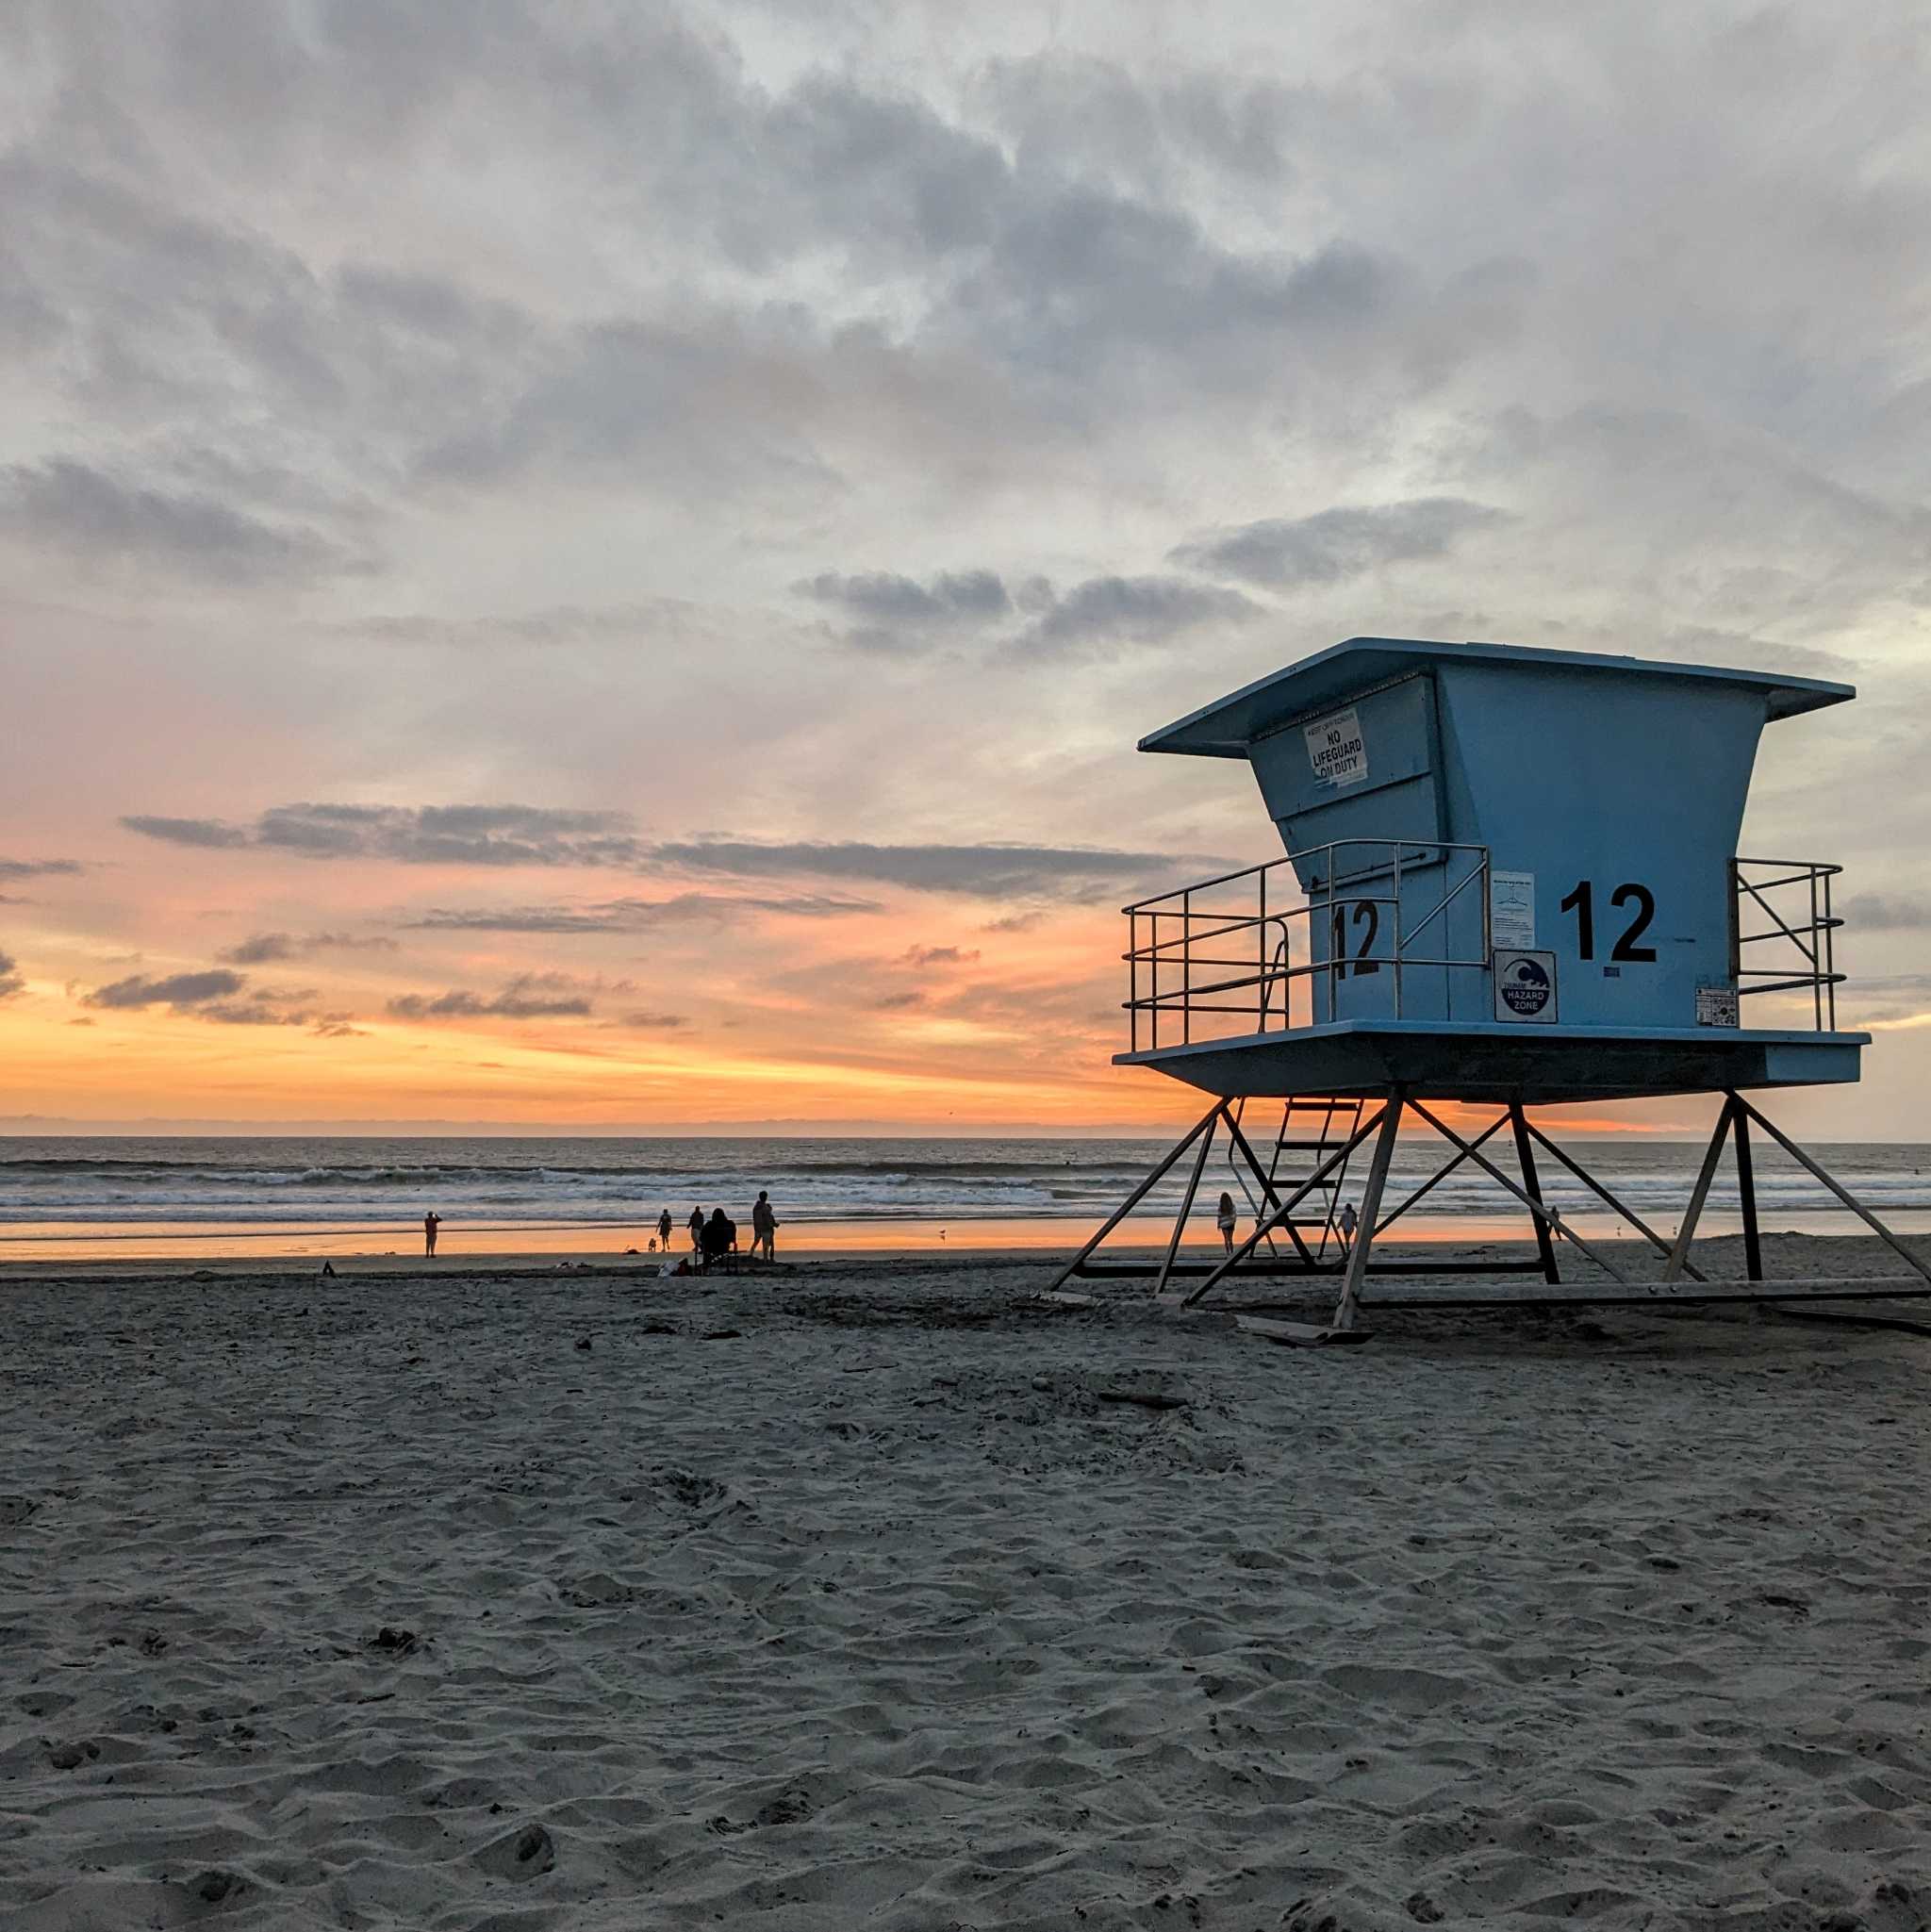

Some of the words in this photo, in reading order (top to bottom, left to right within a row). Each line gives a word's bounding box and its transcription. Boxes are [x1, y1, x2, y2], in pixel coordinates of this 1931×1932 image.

[1327, 730, 1341, 746] NO
[1312, 738, 1362, 768] LIFEGUARD
[1320, 763, 1334, 778] ON
[1334, 755, 1358, 775] DUTY
[1560, 881, 1657, 963] 12
[1333, 899, 1378, 980] 12
[1508, 990, 1544, 1000] HAZARD
[1513, 1000, 1539, 1010] ZONE
